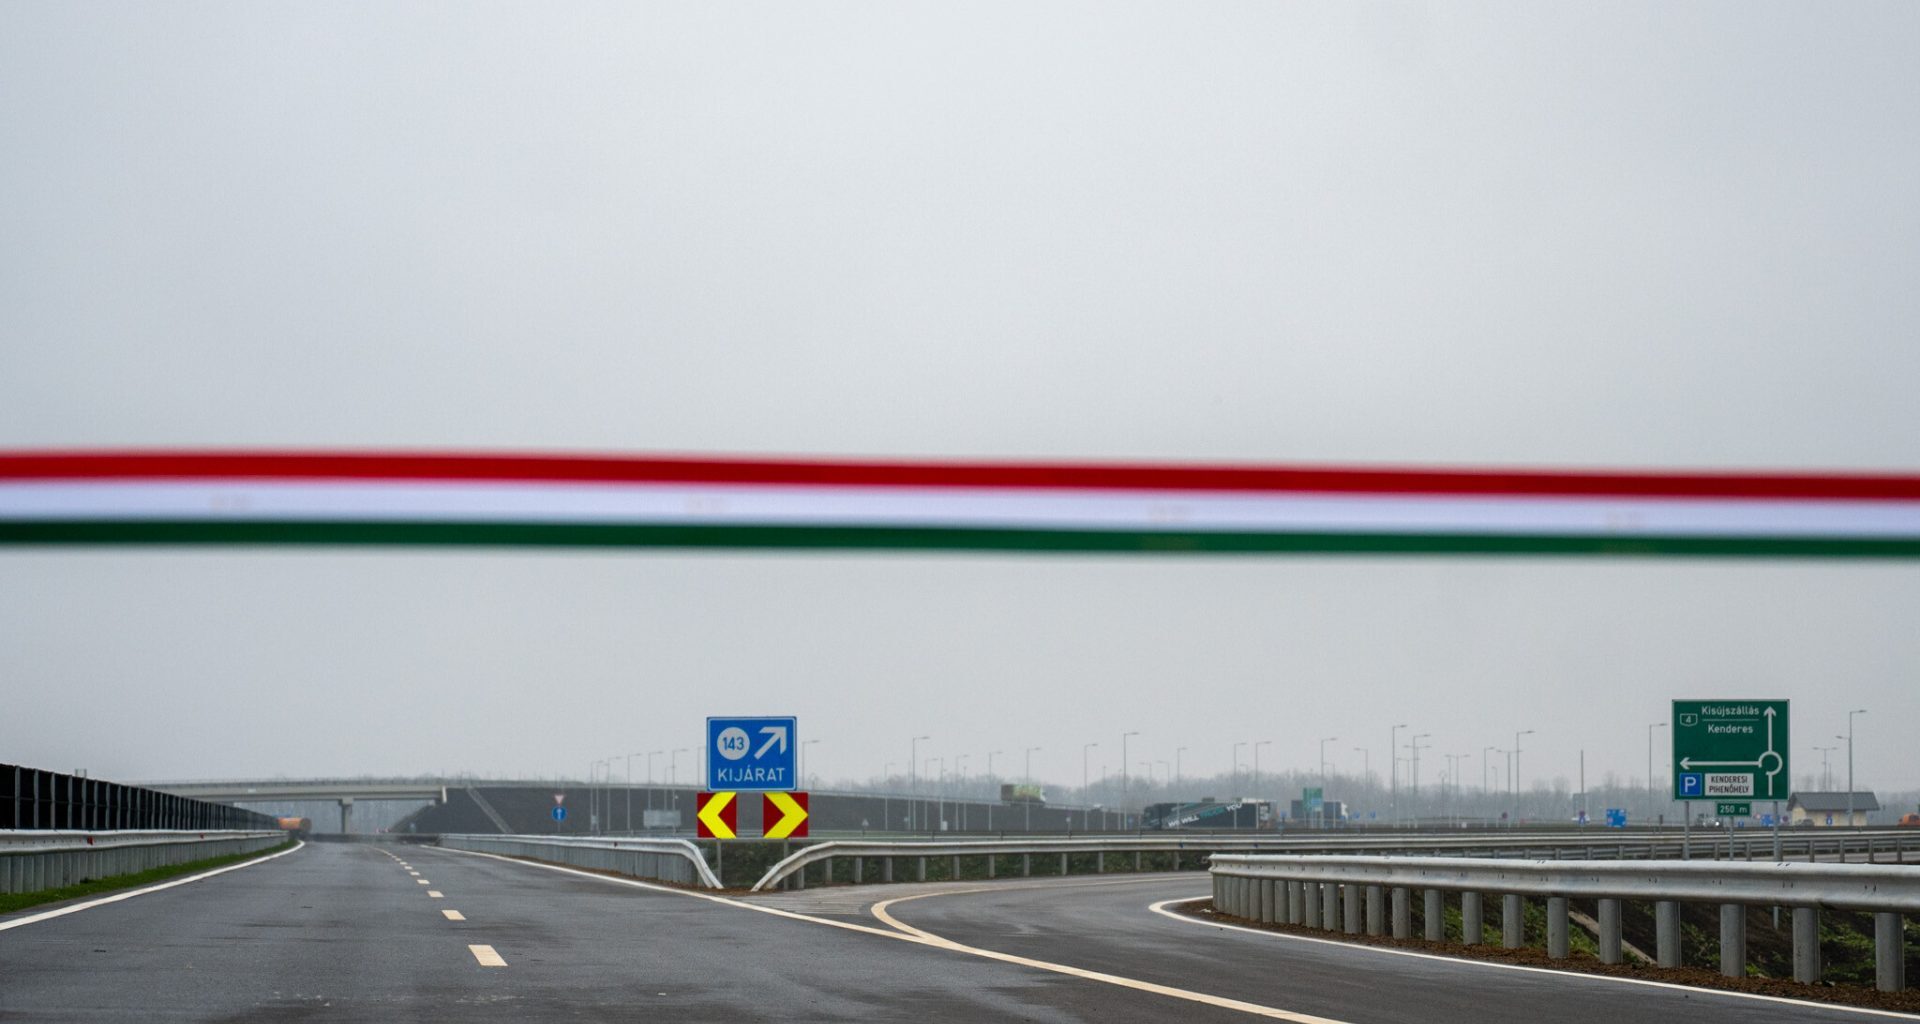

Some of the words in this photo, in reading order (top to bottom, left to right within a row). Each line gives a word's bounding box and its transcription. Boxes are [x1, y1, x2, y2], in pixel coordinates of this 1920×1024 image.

[1701, 705, 1760, 717] Kisújszállás
[1685, 715, 1692, 723] 4
[1708, 724, 1753, 733] Kenderes
[722, 736, 745, 751] 143
[718, 764, 786, 782] KIJÁRAT
[1684, 776, 1697, 793] P
[1709, 784, 1750, 793] PIHENŐHELY
[1720, 805, 1735, 813] 250
